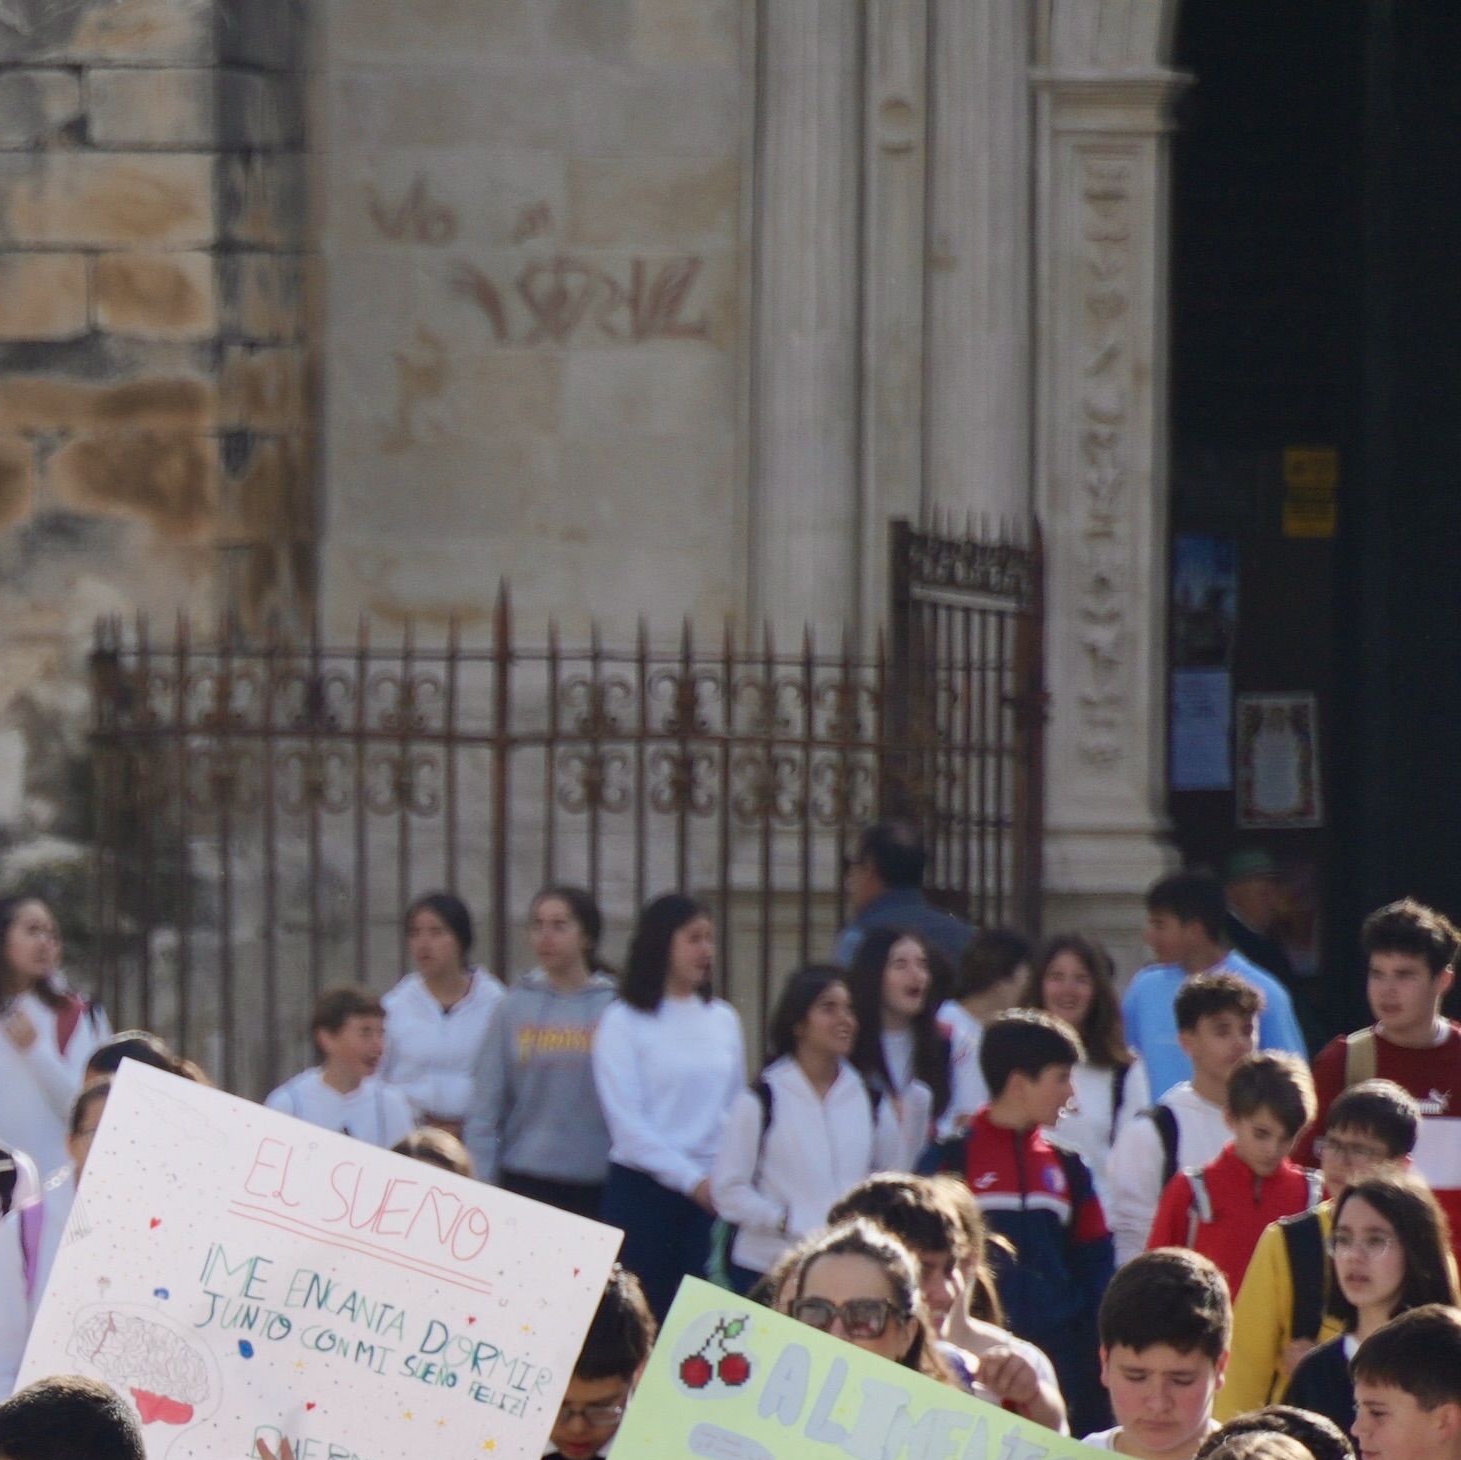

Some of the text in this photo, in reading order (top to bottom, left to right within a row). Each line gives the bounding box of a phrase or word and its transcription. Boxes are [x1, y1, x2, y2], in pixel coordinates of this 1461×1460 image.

[244, 1137, 490, 1262] EL SUEÑO
[193, 1289, 293, 1341] JUNTO
[284, 1267, 408, 1341] ENCANTA
[419, 1319, 553, 1395] DORMIR
